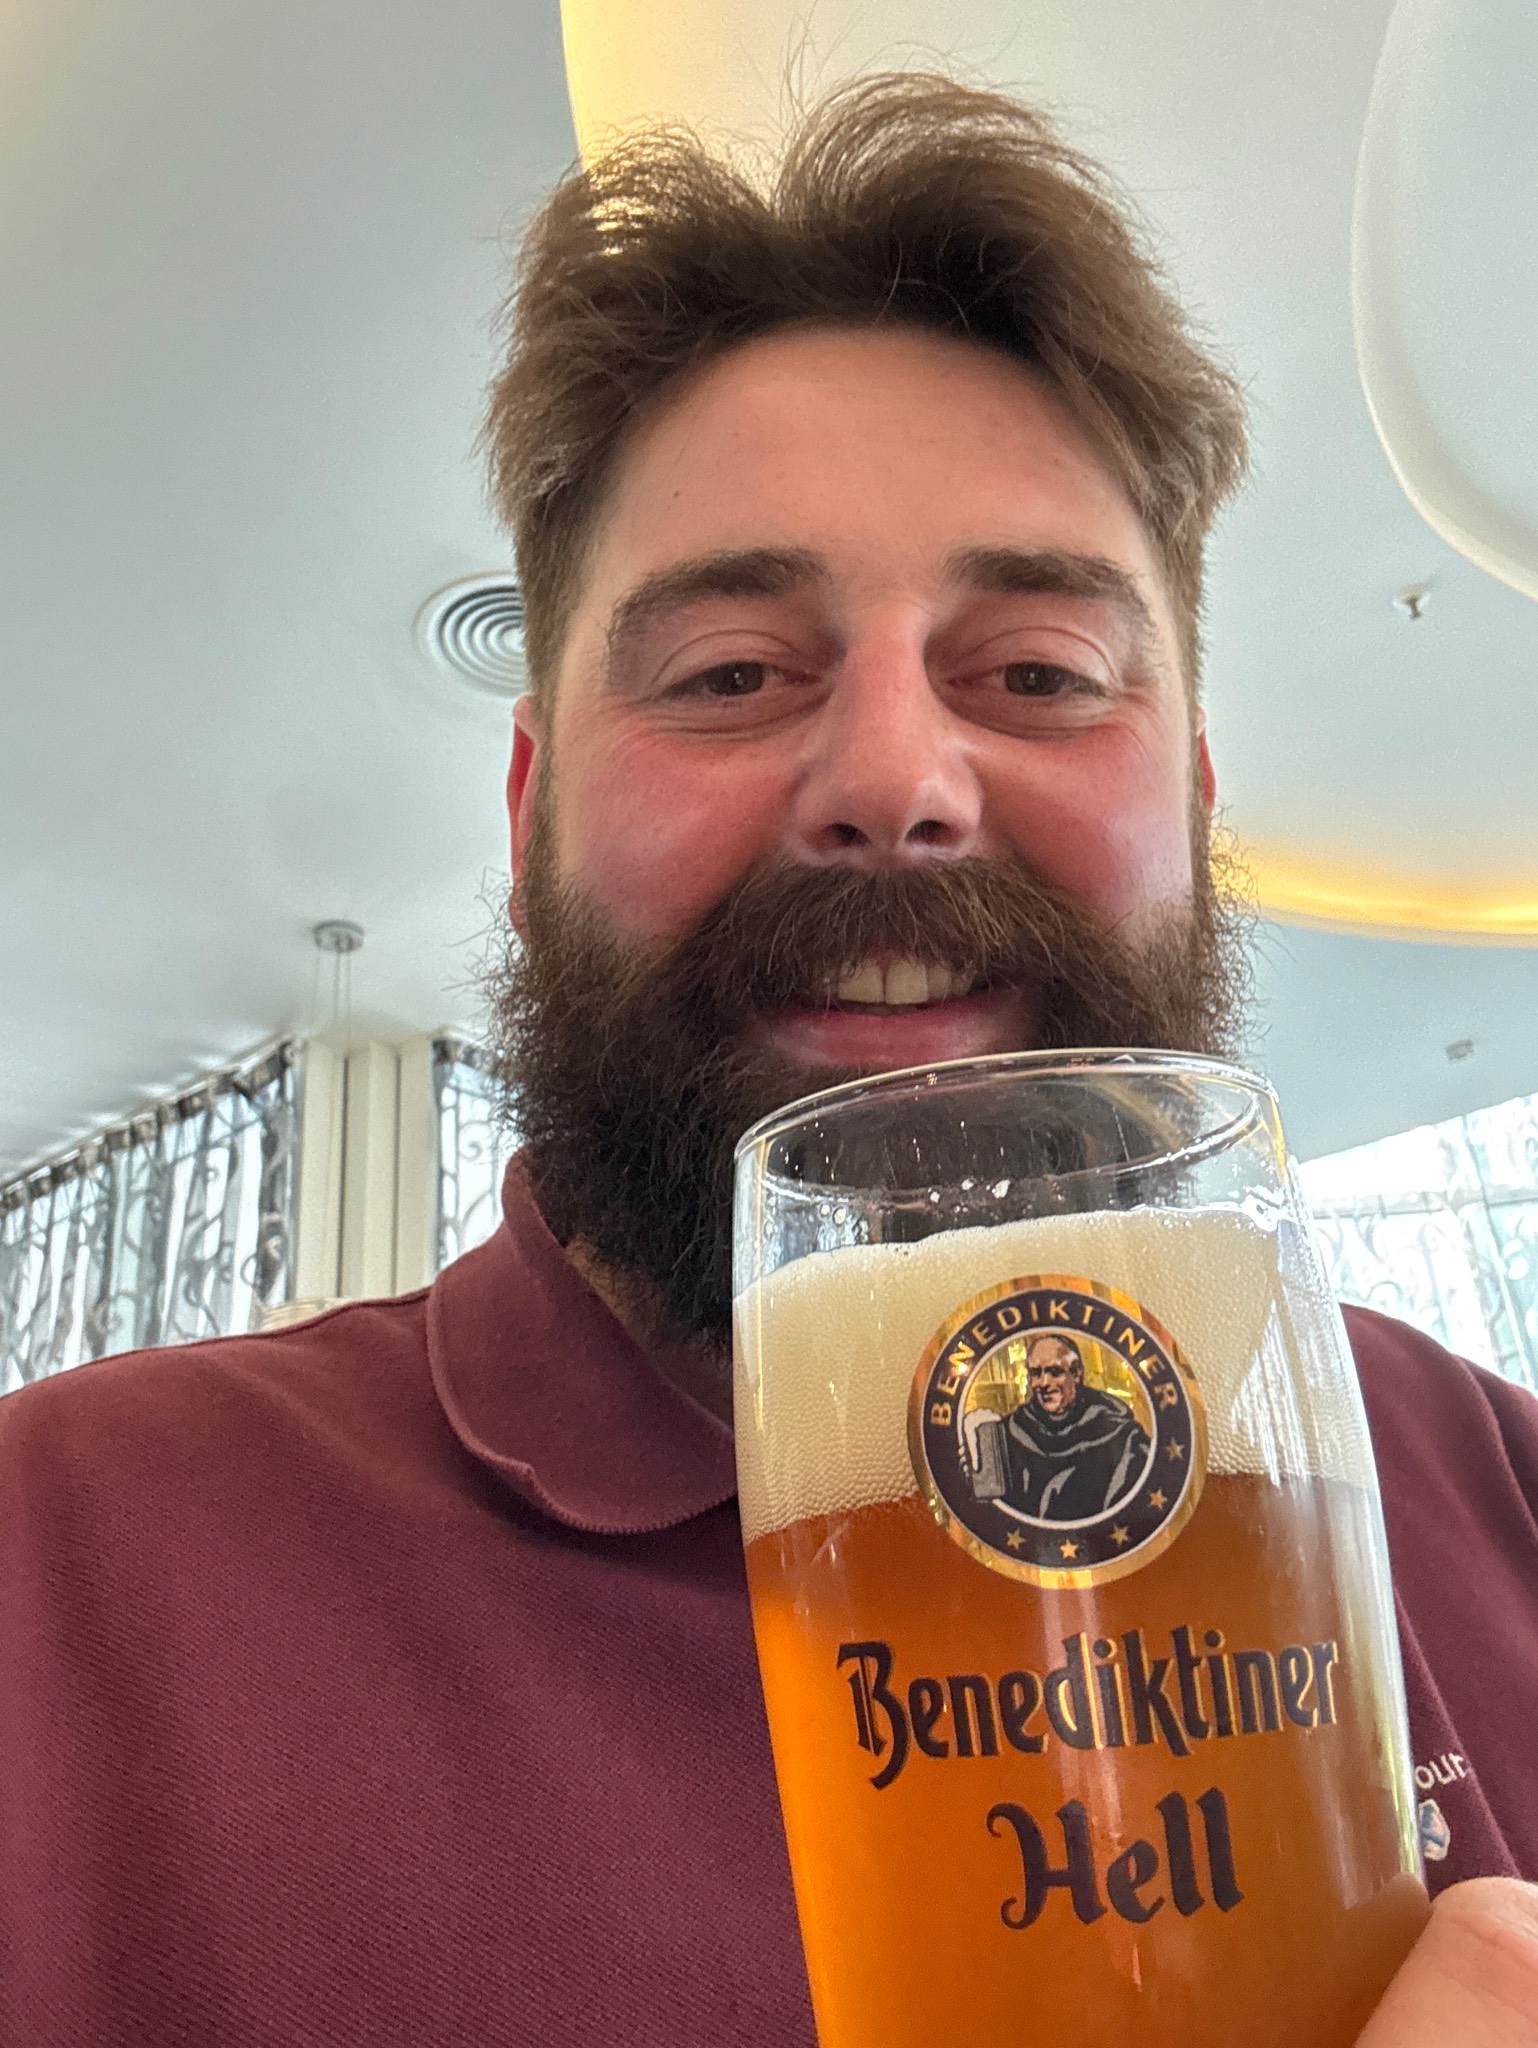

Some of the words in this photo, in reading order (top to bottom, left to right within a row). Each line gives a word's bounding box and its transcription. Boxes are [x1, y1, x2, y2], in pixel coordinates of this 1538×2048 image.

[931, 1300, 1178, 1426] BENEDIKTINER
[837, 1625, 1338, 1790] Benediktiner
[986, 1787, 1244, 1930] Hell
